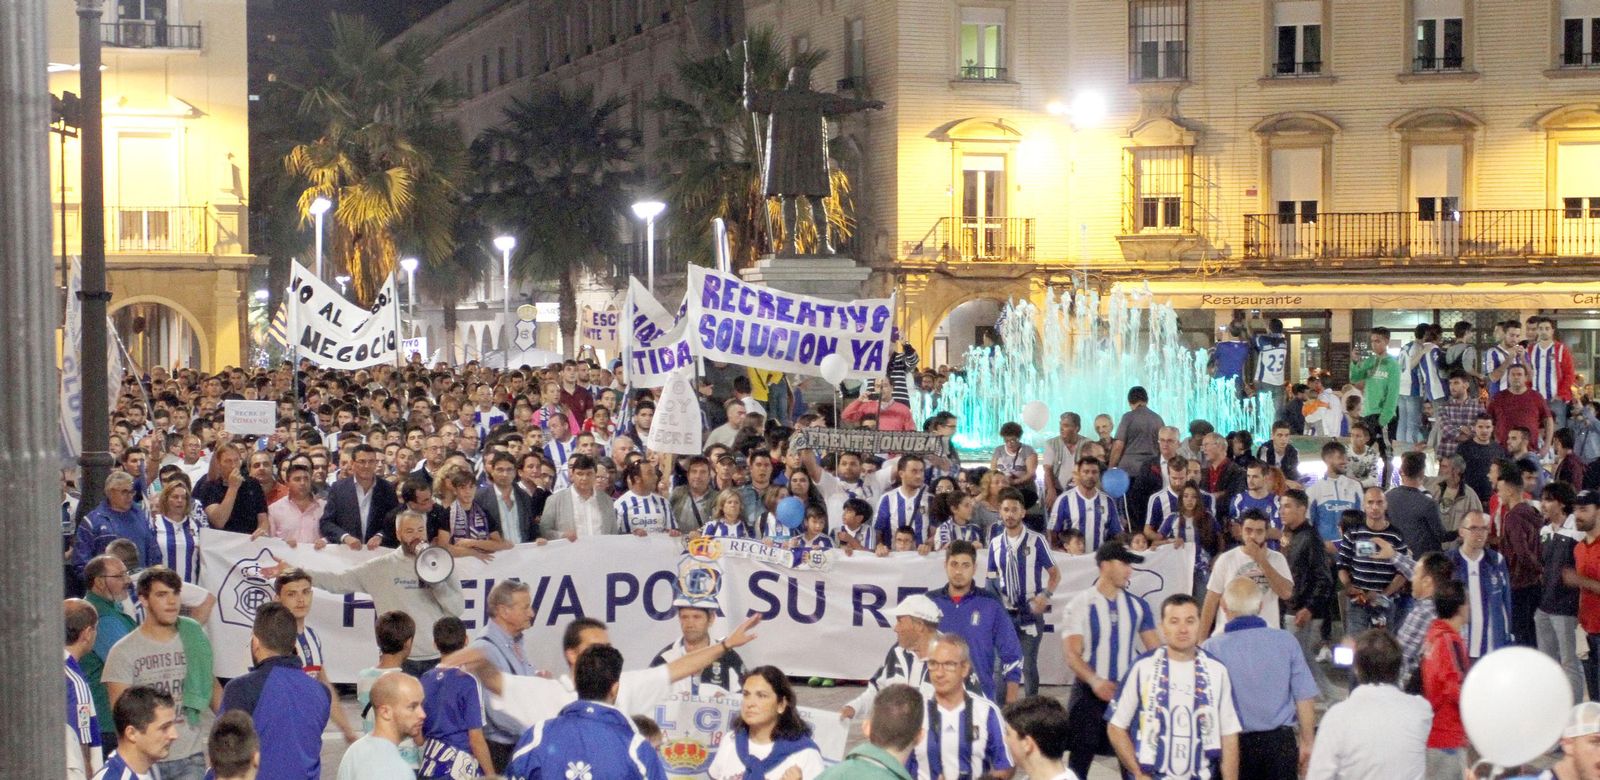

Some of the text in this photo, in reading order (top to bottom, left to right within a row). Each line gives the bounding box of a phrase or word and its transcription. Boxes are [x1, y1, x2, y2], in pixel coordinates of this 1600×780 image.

[702, 274, 890, 333] RECREATIVO
[1201, 294, 1302, 305] Restaurante
[318, 301, 342, 328] AL
[593, 312, 619, 326] ESC
[698, 314, 839, 367] SOLUCION
[851, 339, 884, 372] YA
[632, 340, 693, 375] TIDA
[1266, 353, 1285, 372] 23
[808, 432, 873, 450] FRENTE
[631, 516, 658, 527] Cajas
[730, 540, 777, 557] RECRE
[746, 570, 827, 625] SU
[134, 652, 171, 677] SPORTS
